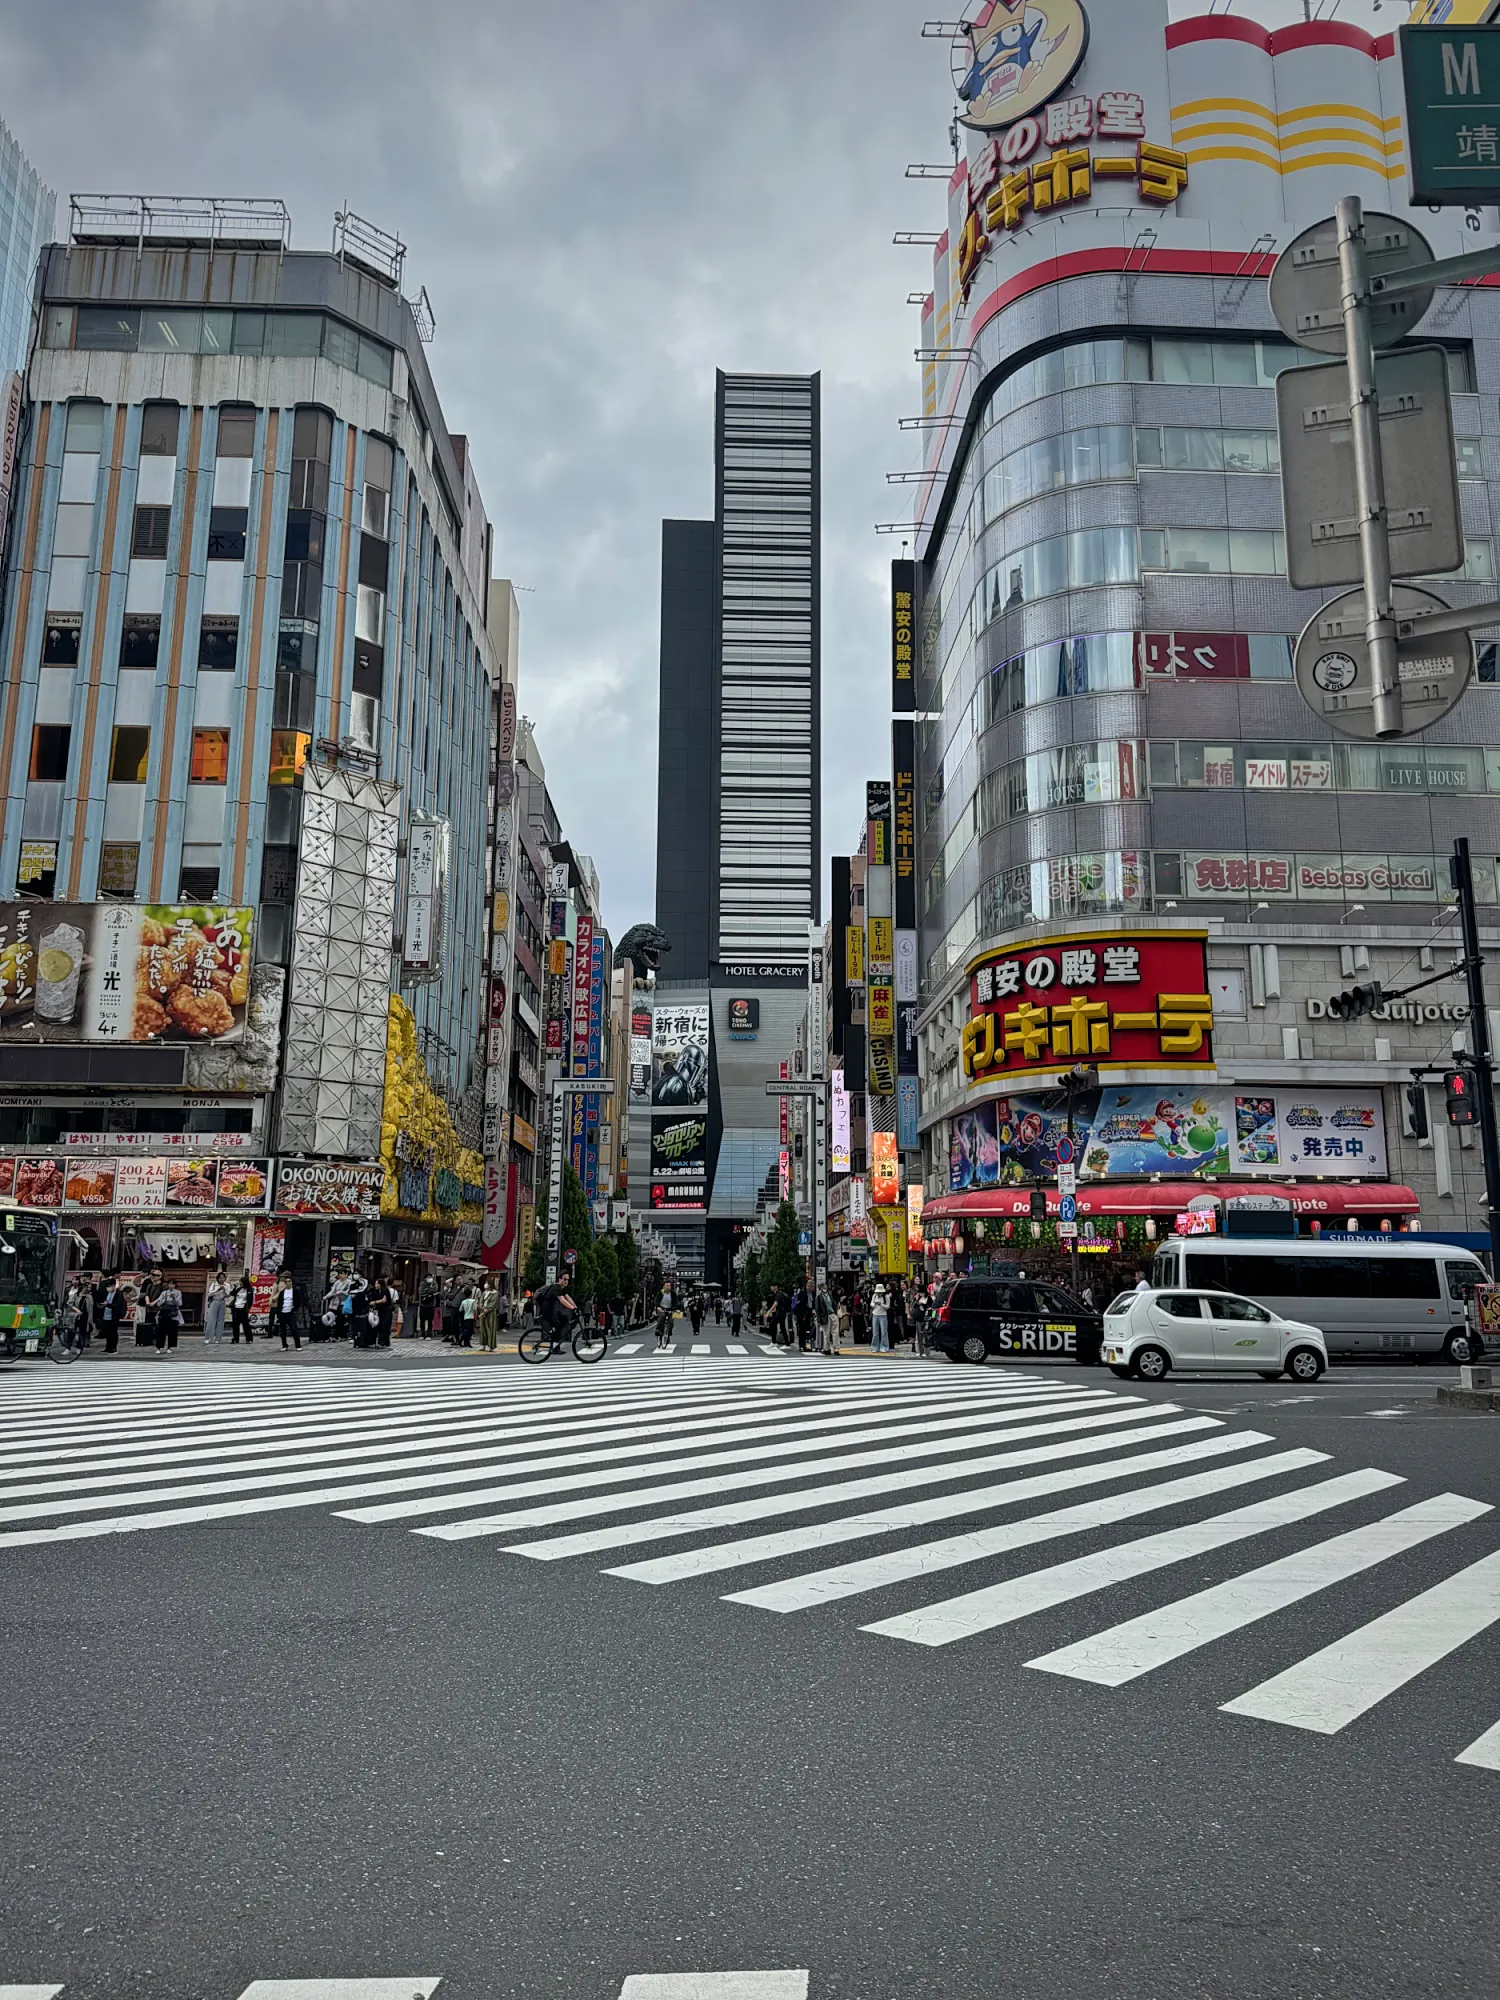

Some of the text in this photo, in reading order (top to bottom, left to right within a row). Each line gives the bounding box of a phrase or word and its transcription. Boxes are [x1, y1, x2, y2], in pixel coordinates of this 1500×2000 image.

[1441, 43, 1481, 95] M
[895, 592, 912, 680] 驚安の殿堂
[1204, 762, 1331, 787] 新宿 アイドル ステージ
[1389, 769, 1467, 787] LIVE HOUSE
[1195, 857, 1290, 891] 免税店
[1300, 865, 1433, 888] Bebas Cukai
[874, 920, 883, 952] 生ビール
[103, 971, 121, 990] 光
[574, 921, 591, 1036] カラオケ歌広場
[725, 966, 804, 976] HOTEL GRACERY
[873, 976, 889, 986] 4F
[976, 947, 1141, 1004] 驚安の殿堂
[872, 988, 890, 1020] 麻雀
[1307, 999, 1341, 1019] Do
[98, 1020, 118, 1036] 4F
[656, 1016, 708, 1034] 新宿に
[655, 1034, 708, 1047] 帰ってくる
[870, 1039, 893, 1091] CASINO
[183, 1099, 221, 1107] MONJA
[1111, 1114, 1140, 1122] SUPER
[1302, 1137, 1364, 1157] 発売中
[119, 1165, 165, 1176] 200 えん
[221, 1161, 257, 1172] らーめん
[548, 1106, 562, 1236] GODZILLA ROAD
[281, 1167, 386, 1188] OKONOMIYAKI
[116, 1195, 140, 1206] 200
[285, 1185, 376, 1206] お好み焼き
[487, 1167, 499, 1215] トラノコ
[667, 1185, 704, 1196] MARUHAN
[1000, 1322, 1044, 1331] タクシーアプリ
[1000, 1329, 1077, 1352] S.RIDE
